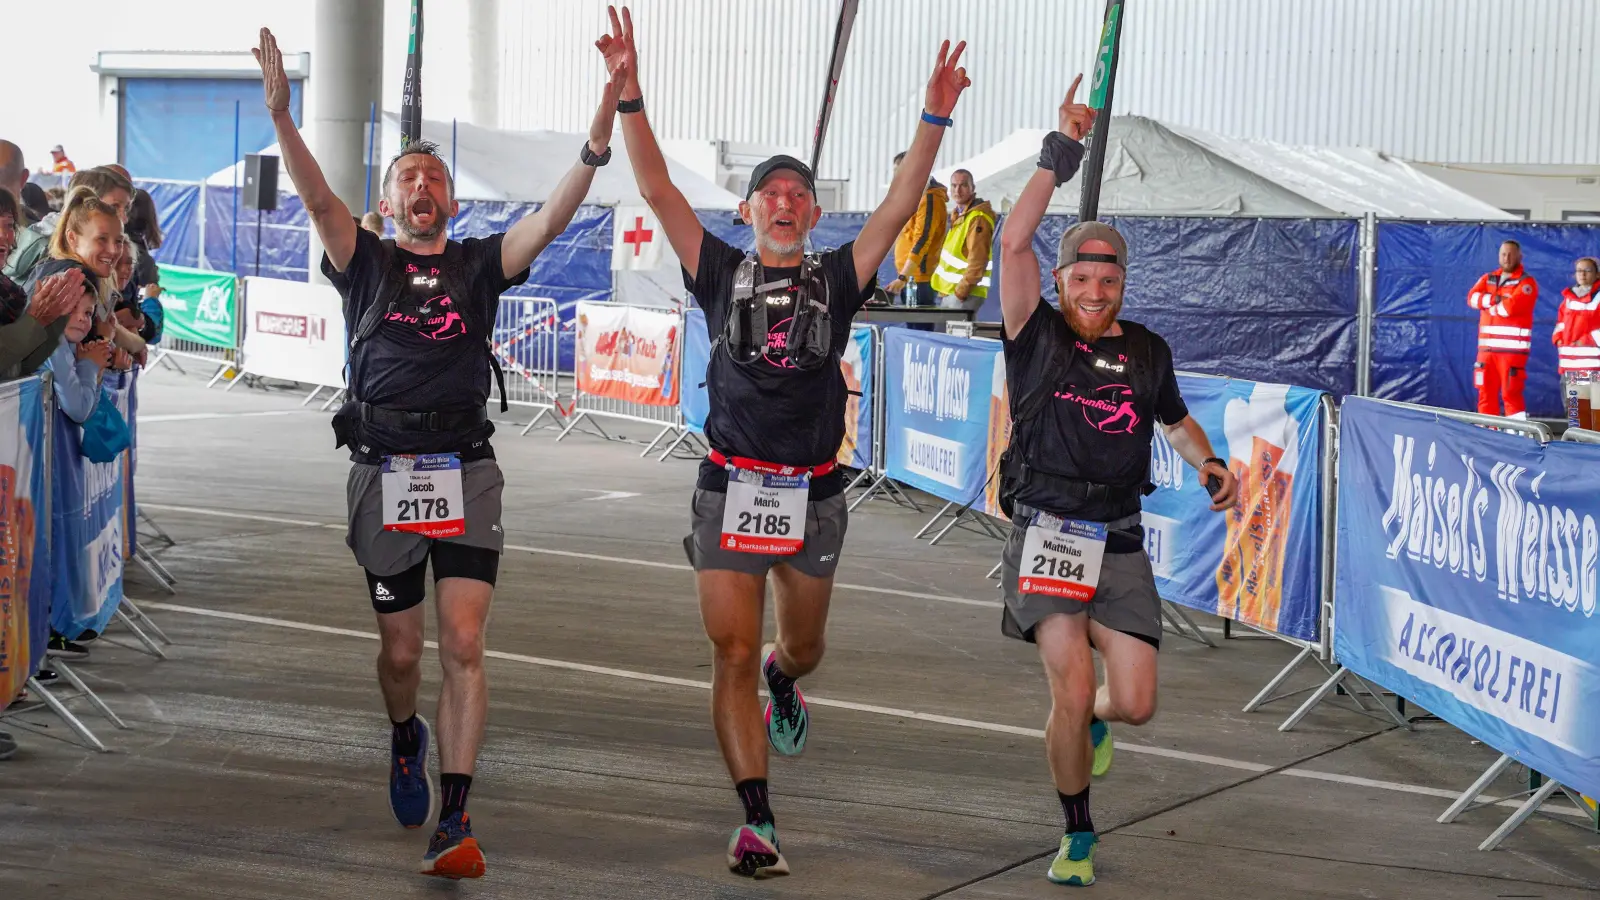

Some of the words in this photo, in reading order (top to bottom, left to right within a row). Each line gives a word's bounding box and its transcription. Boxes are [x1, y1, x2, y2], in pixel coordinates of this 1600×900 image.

[196, 286, 231, 322] AOK
[902, 342, 937, 414] Maisel's
[936, 346, 970, 422] Weisse
[910, 439, 957, 478] ALKOHOLFREI
[407, 482, 434, 493] Jacob
[397, 497, 450, 522] 2178
[753, 496, 780, 508] Mario
[432, 526, 460, 535] Bayreuth
[737, 511, 791, 535] 2185
[1382, 434, 1488, 583] Maisel's
[1490, 461, 1599, 618] Weisse
[738, 542, 769, 551] Sparkasse
[769, 544, 797, 553] Bayreuth
[1042, 540, 1082, 557] Matthias
[1031, 555, 1085, 582] 2184
[1032, 583, 1062, 593] Sparkasse
[1062, 587, 1089, 599] Bayreuth
[1399, 612, 1562, 724] ALKOHOLFREI
